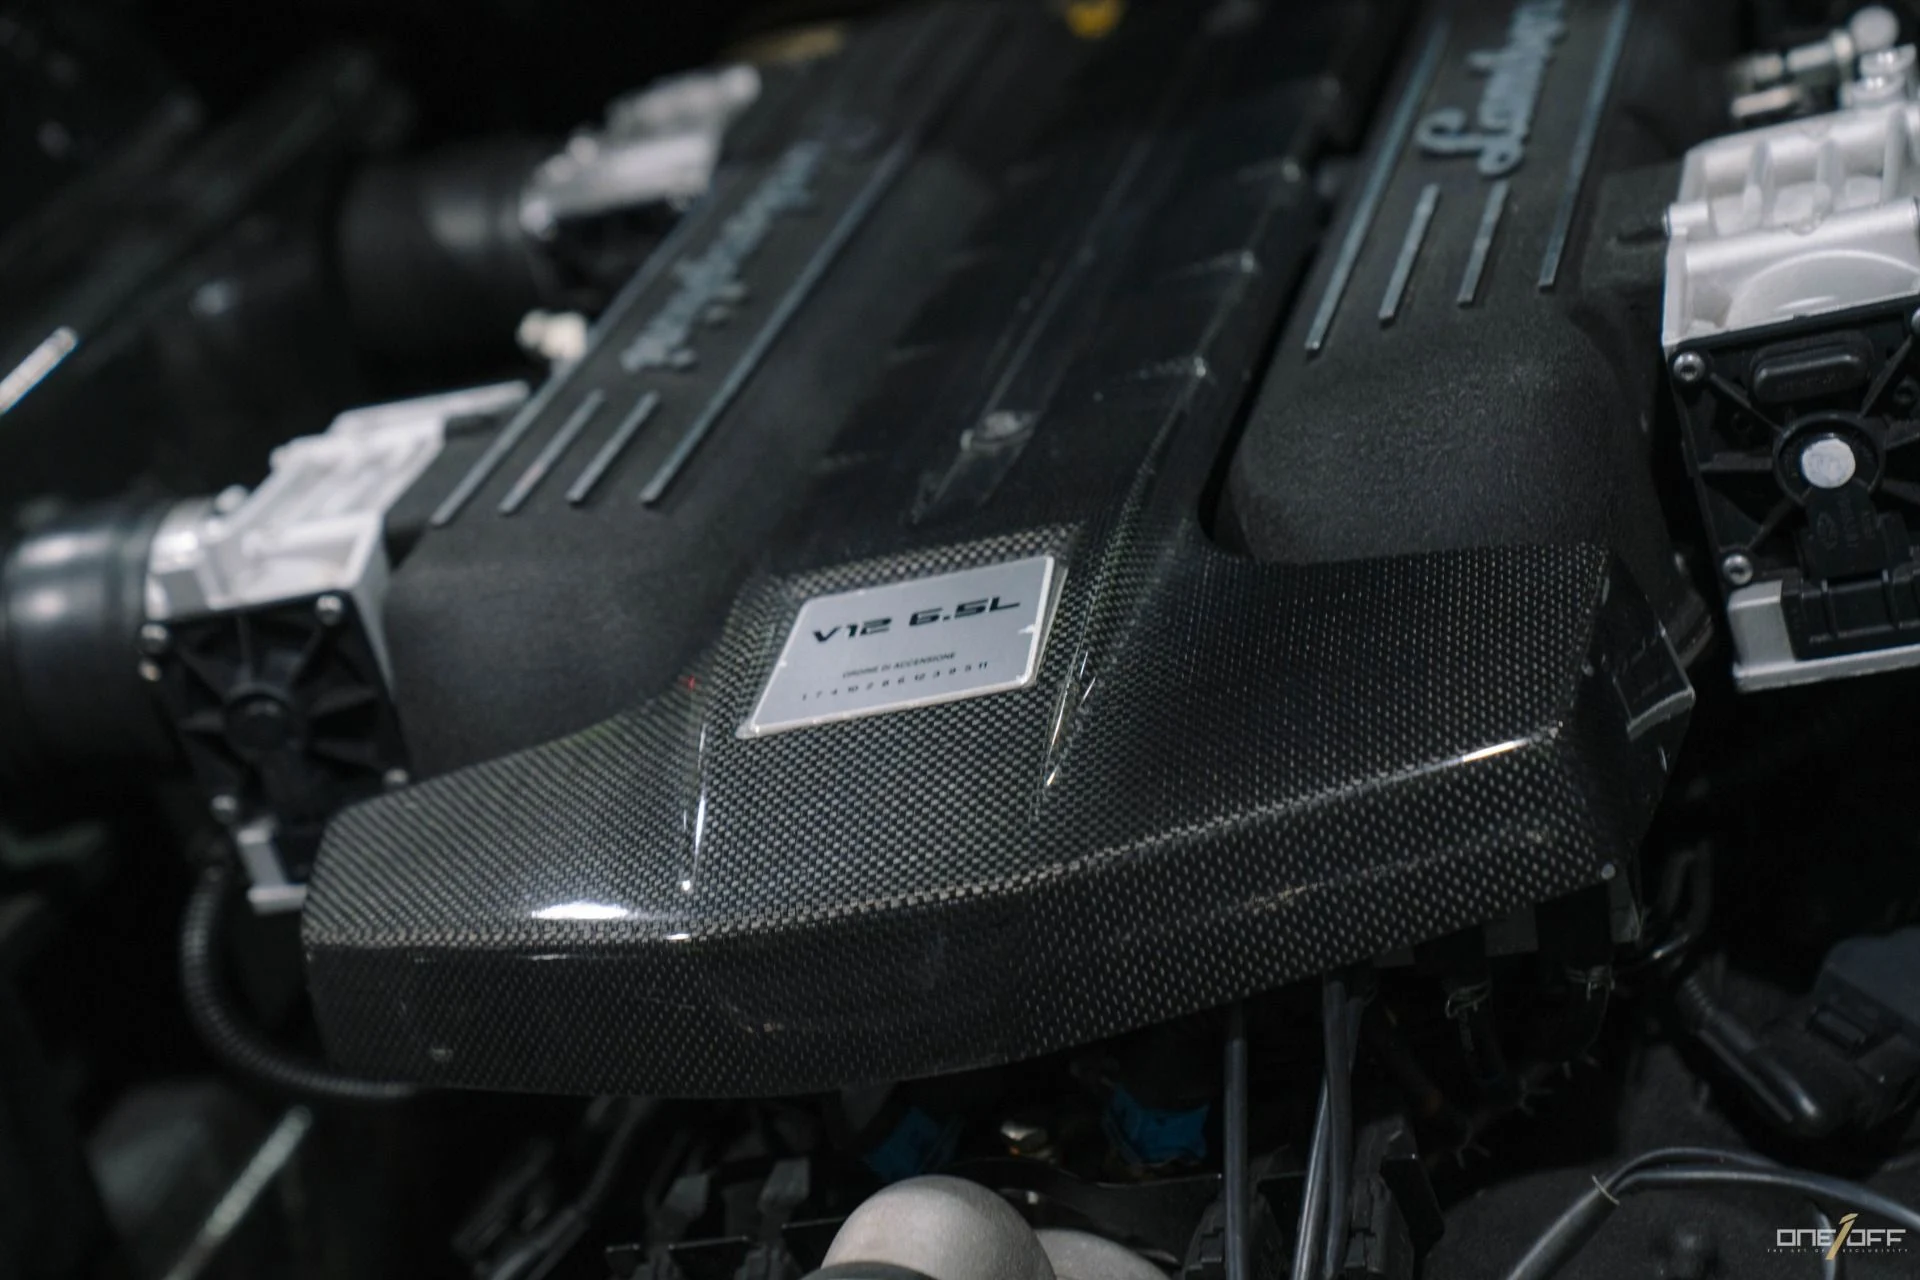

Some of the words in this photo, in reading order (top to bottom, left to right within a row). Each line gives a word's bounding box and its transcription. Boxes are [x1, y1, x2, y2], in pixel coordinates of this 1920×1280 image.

[813, 616, 892, 644] V12
[909, 596, 1020, 627] 6.5L
[893, 652, 956, 668] ACCENSIONE
[978, 661, 989, 670] 11
